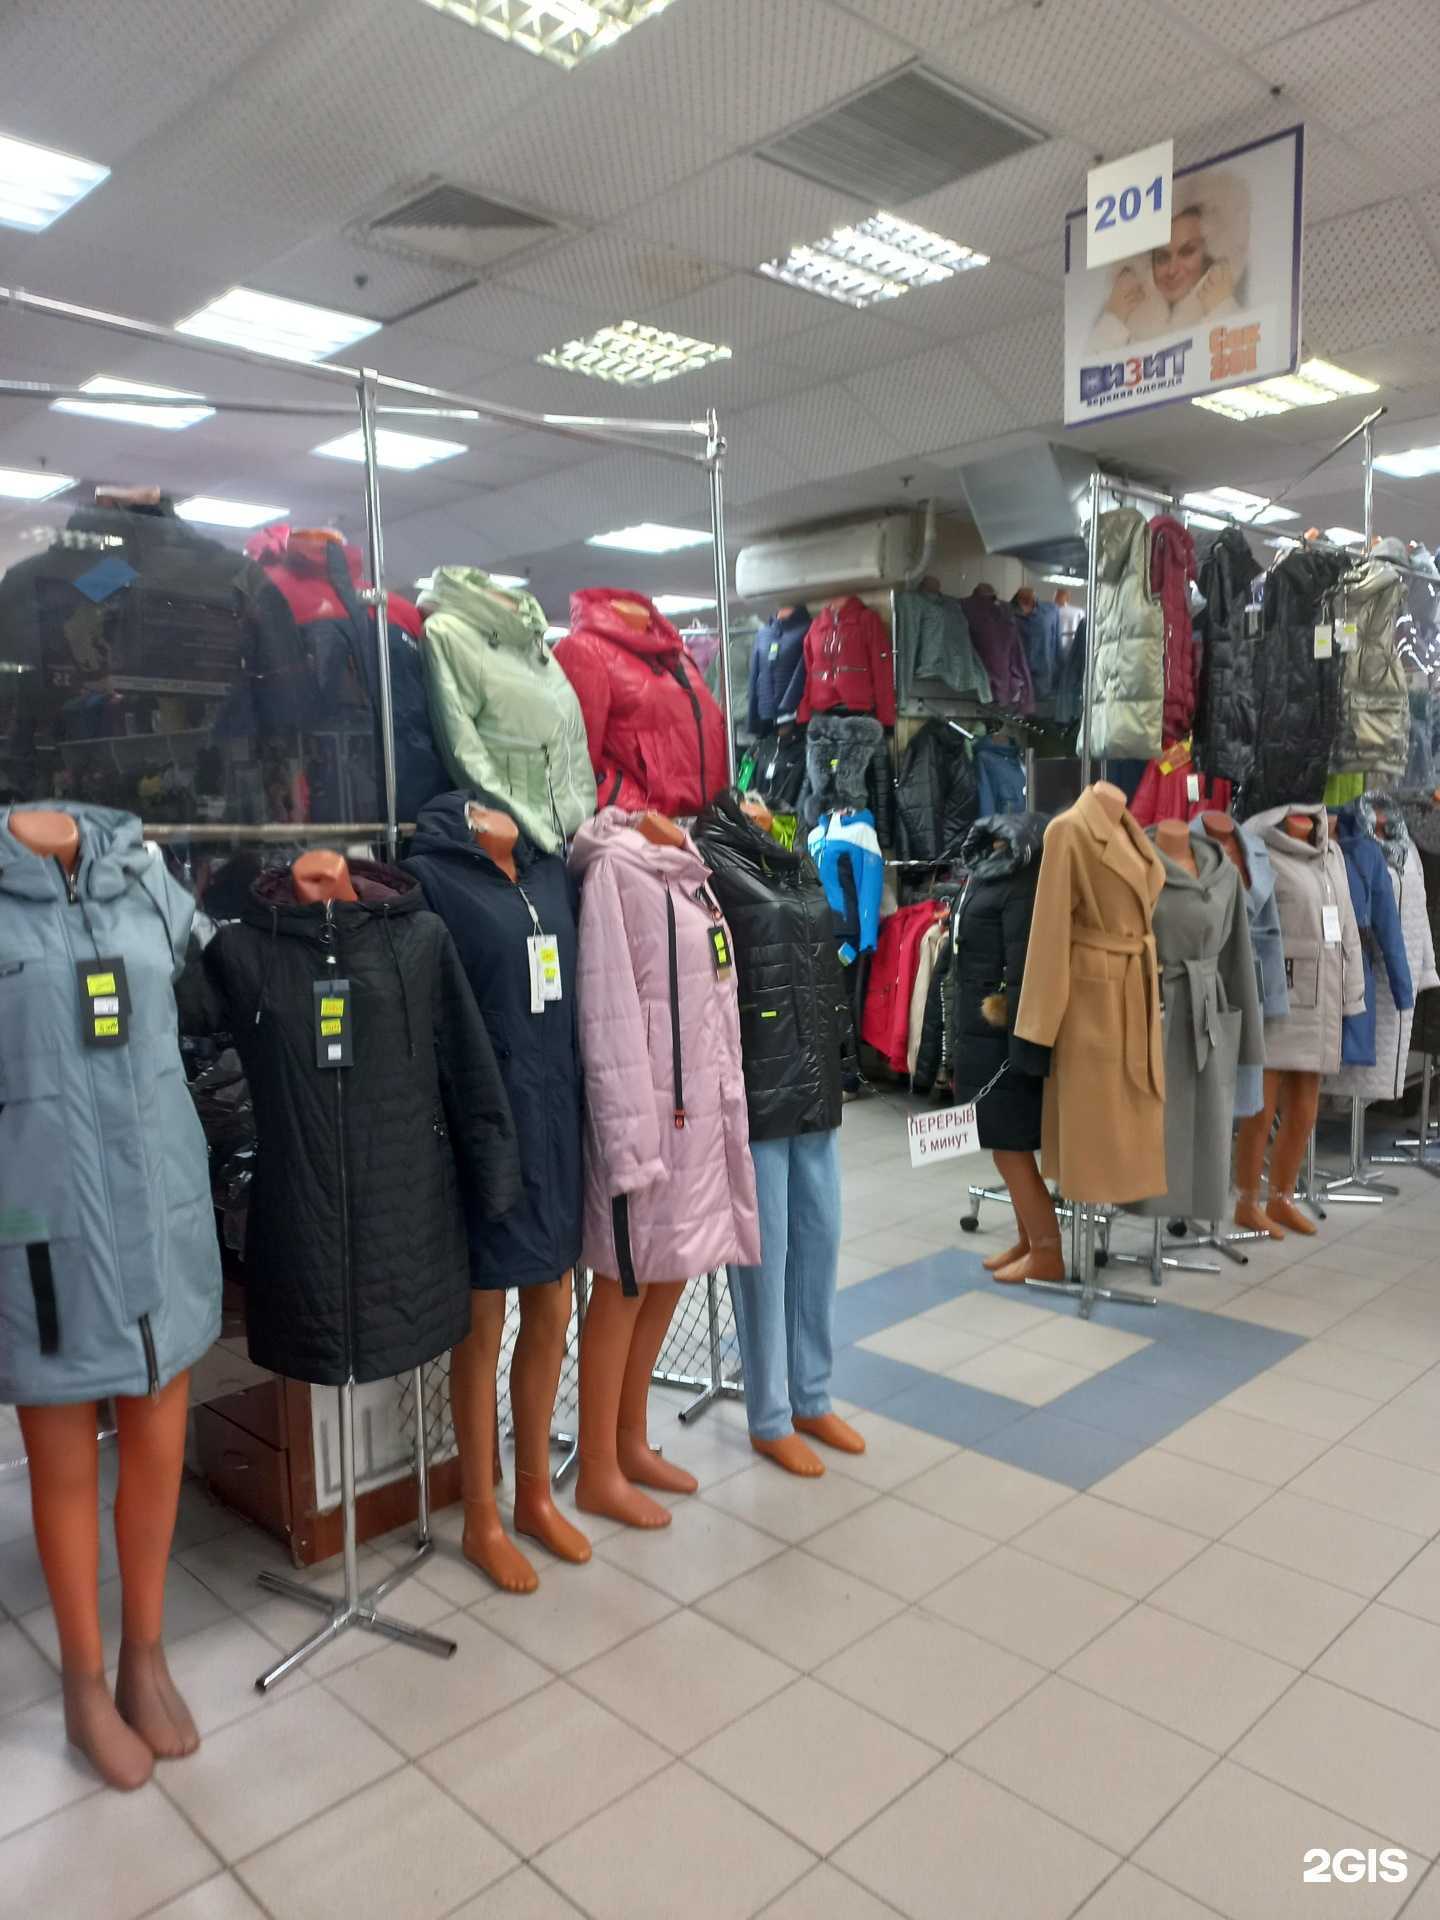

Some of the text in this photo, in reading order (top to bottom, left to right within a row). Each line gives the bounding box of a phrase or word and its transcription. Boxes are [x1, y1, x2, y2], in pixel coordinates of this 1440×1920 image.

[1095, 176, 1163, 232] 201
[1080, 338, 1192, 402] ВИЗИТ
[919, 1139, 926, 1153] 5
